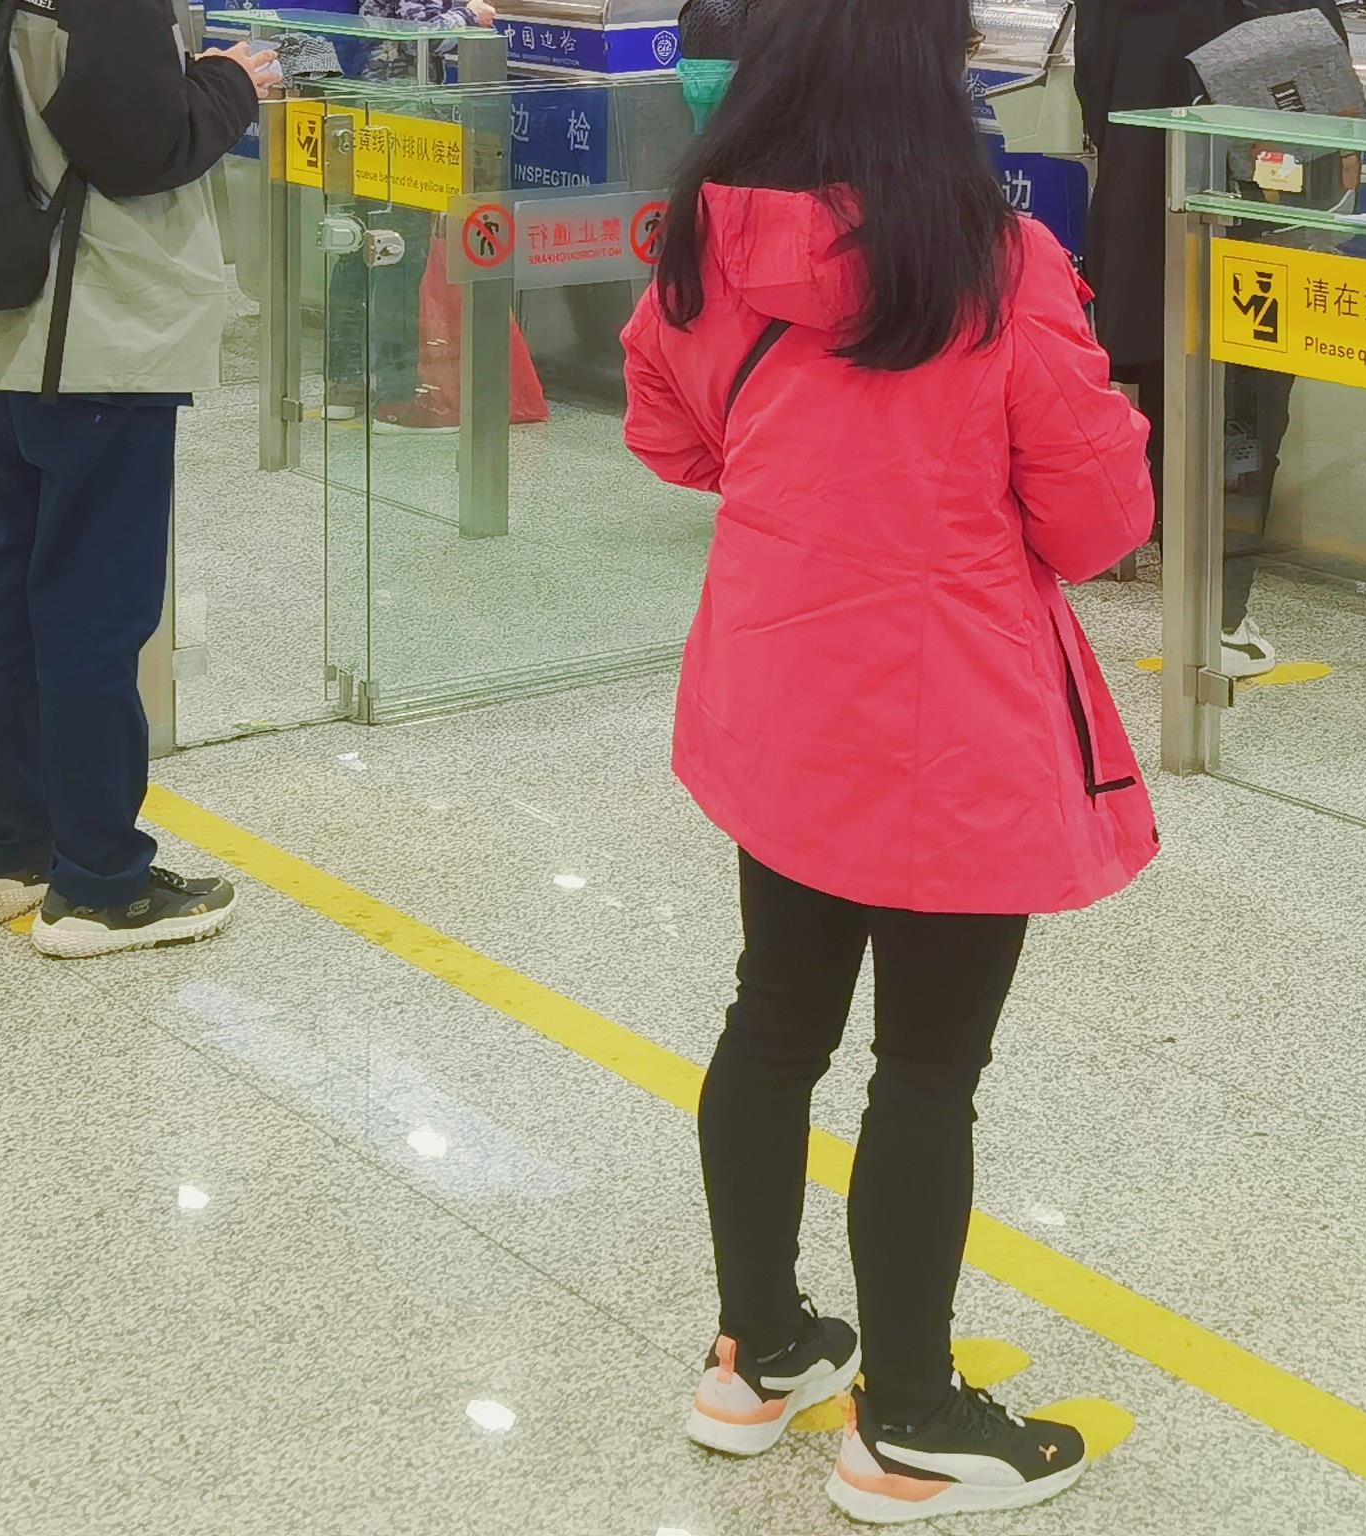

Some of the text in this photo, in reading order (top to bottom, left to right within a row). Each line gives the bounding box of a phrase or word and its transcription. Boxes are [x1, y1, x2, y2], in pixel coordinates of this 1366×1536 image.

[504, 24, 577, 54] 中国边检
[511, 103, 591, 151] 边检
[514, 163, 590, 187] INSPECTION
[1305, 336, 1355, 360] Please
